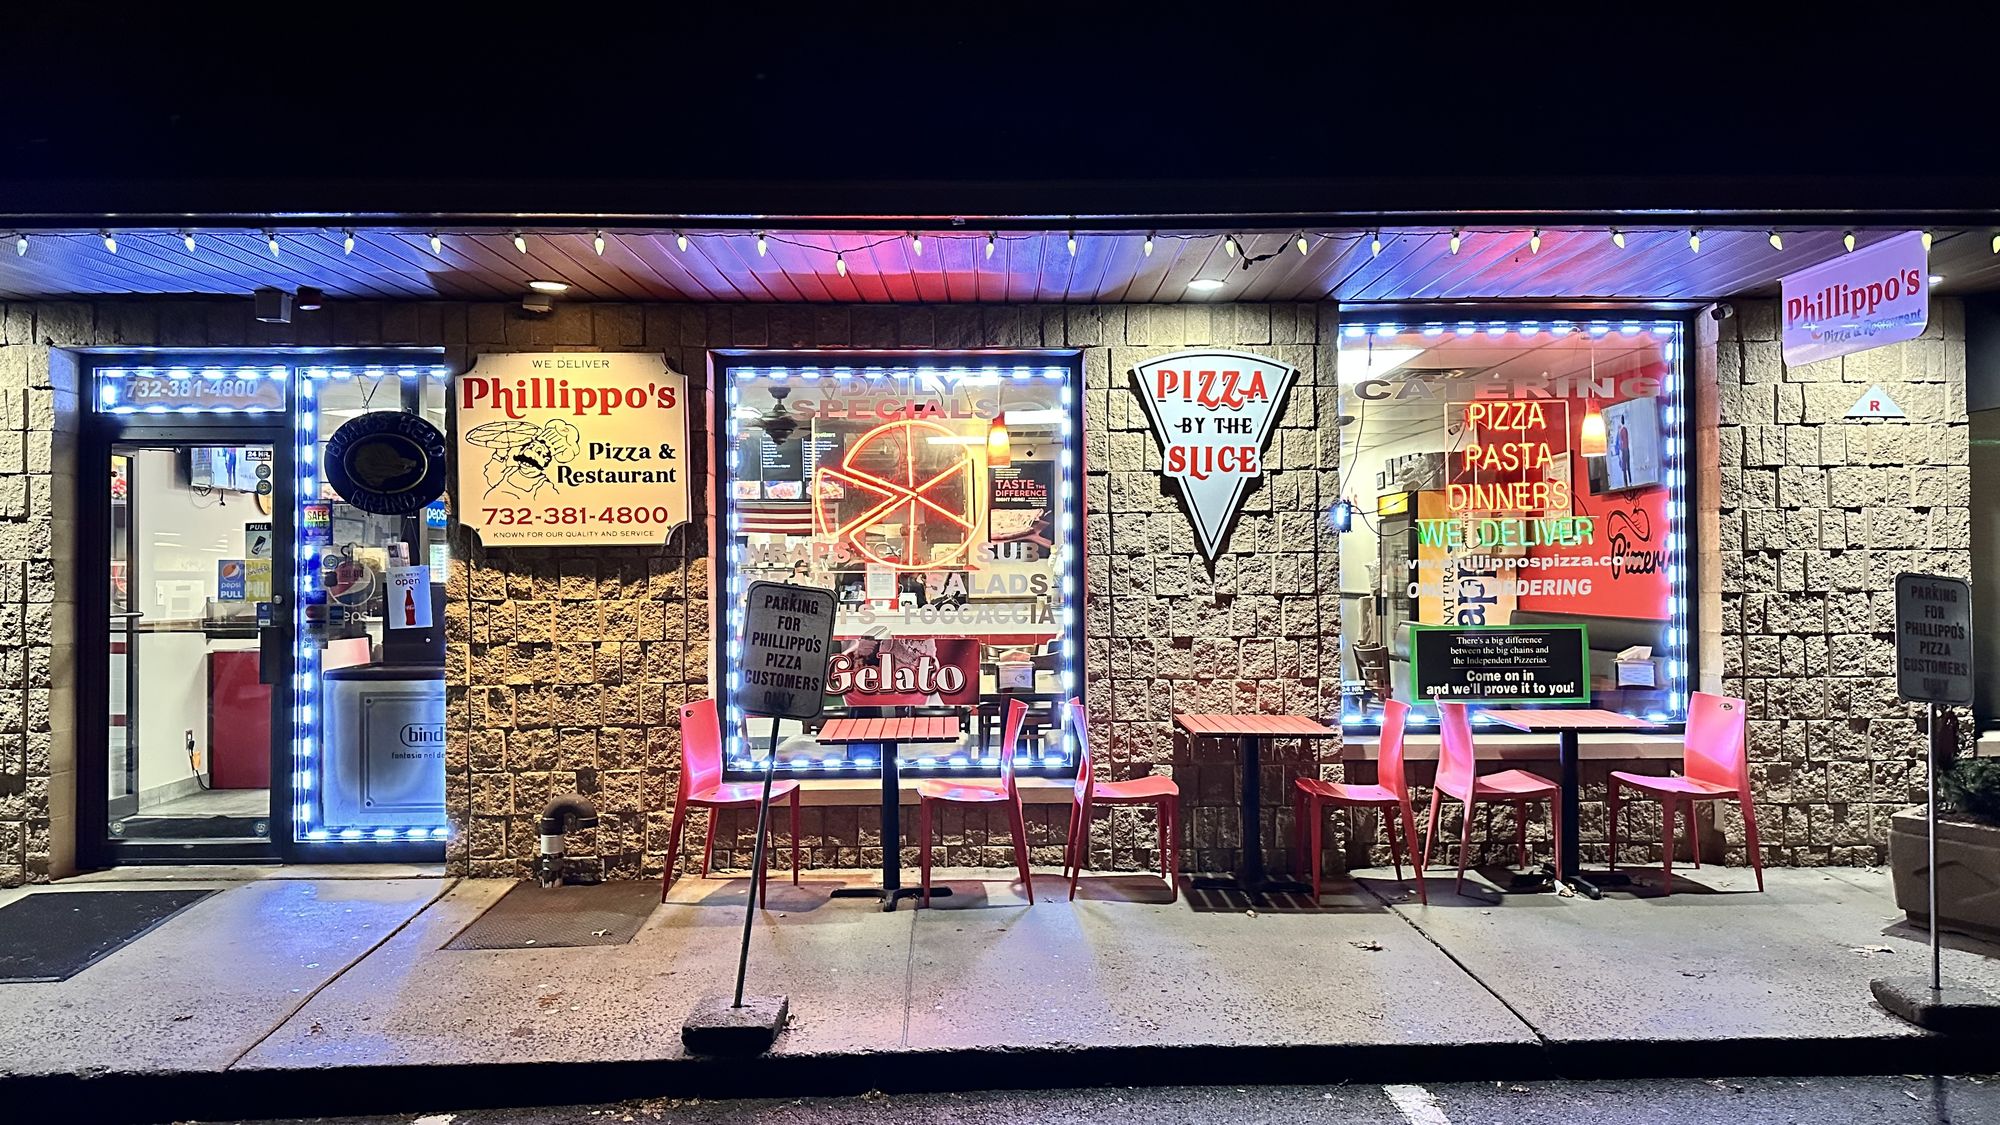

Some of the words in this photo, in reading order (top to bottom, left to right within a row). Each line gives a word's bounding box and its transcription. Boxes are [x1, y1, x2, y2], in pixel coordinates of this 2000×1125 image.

[1787, 269, 1920, 339] Phillippo's
[1824, 329, 1851, 343] Pizza
[532, 360, 550, 368] WE
[557, 360, 609, 368] DELIVER
[126, 380, 258, 397] 732-381-4800
[840, 375, 960, 396] DAILY
[1157, 370, 1269, 410] PIZZA
[1354, 378, 1661, 400] CATERING
[463, 378, 676, 419] Phillippo's
[1870, 401, 1880, 411] R
[792, 399, 999, 420] SPECIALS
[1468, 402, 1546, 431] PIZZA
[1174, 417, 1205, 434] BY
[1213, 417, 1252, 434] THE
[589, 443, 651, 462] Pizza
[659, 444, 676, 459] &
[1465, 443, 1554, 472] PASTA
[1168, 445, 1257, 481] SLICE
[557, 466, 676, 486] Restaurant
[995, 480, 1034, 489] TASTE
[1448, 482, 1570, 511] DINNERS
[308, 511, 327, 520] SAFE
[482, 507, 668, 525] 732-381-4800
[1418, 519, 1462, 547] WE
[1480, 518, 1594, 546] DELIVER
[738, 542, 851, 563] WRAPS
[977, 543, 1039, 562] SUB
[395, 579, 420, 587] open
[925, 573, 1048, 595] SALADS
[1911, 586, 1957, 602] PARKING
[765, 594, 819, 615] PARKING
[1924, 605, 1945, 619] FOR
[345, 609, 373, 624] epsi
[777, 616, 801, 631] FOR
[1905, 621, 1965, 639] PHILLIPPO'S
[752, 632, 821, 653] PHILLIPPO'S
[1456, 637, 1484, 645] There's
[1491, 636, 1504, 646] big
[1505, 636, 1542, 644] difference
[1920, 641, 1951, 656] PIZZA
[1450, 647, 1481, 655] between
[1496, 646, 1509, 656] big
[1510, 646, 1534, 654] chains
[1535, 646, 1549, 654] and
[765, 653, 802, 670] PIZZA
[1453, 657, 1465, 665] the
[1466, 656, 1512, 666] Independent
[1513, 656, 1547, 664] Pizzerias
[1903, 658, 1967, 676] CUSTOMERS
[745, 670, 820, 691] CUSTOMERS
[825, 652, 966, 694] Gelato
[1466, 670, 1501, 681] Come
[1504, 672, 1520, 681] on
[1523, 669, 1535, 681] in
[1426, 684, 1449, 695] and
[1452, 683, 1481, 694] we'll
[1484, 684, 1518, 696] prove
[1521, 682, 1529, 693] it
[1533, 683, 1546, 693] to
[1549, 682, 1575, 695] you!
[408, 726, 444, 742] bind
